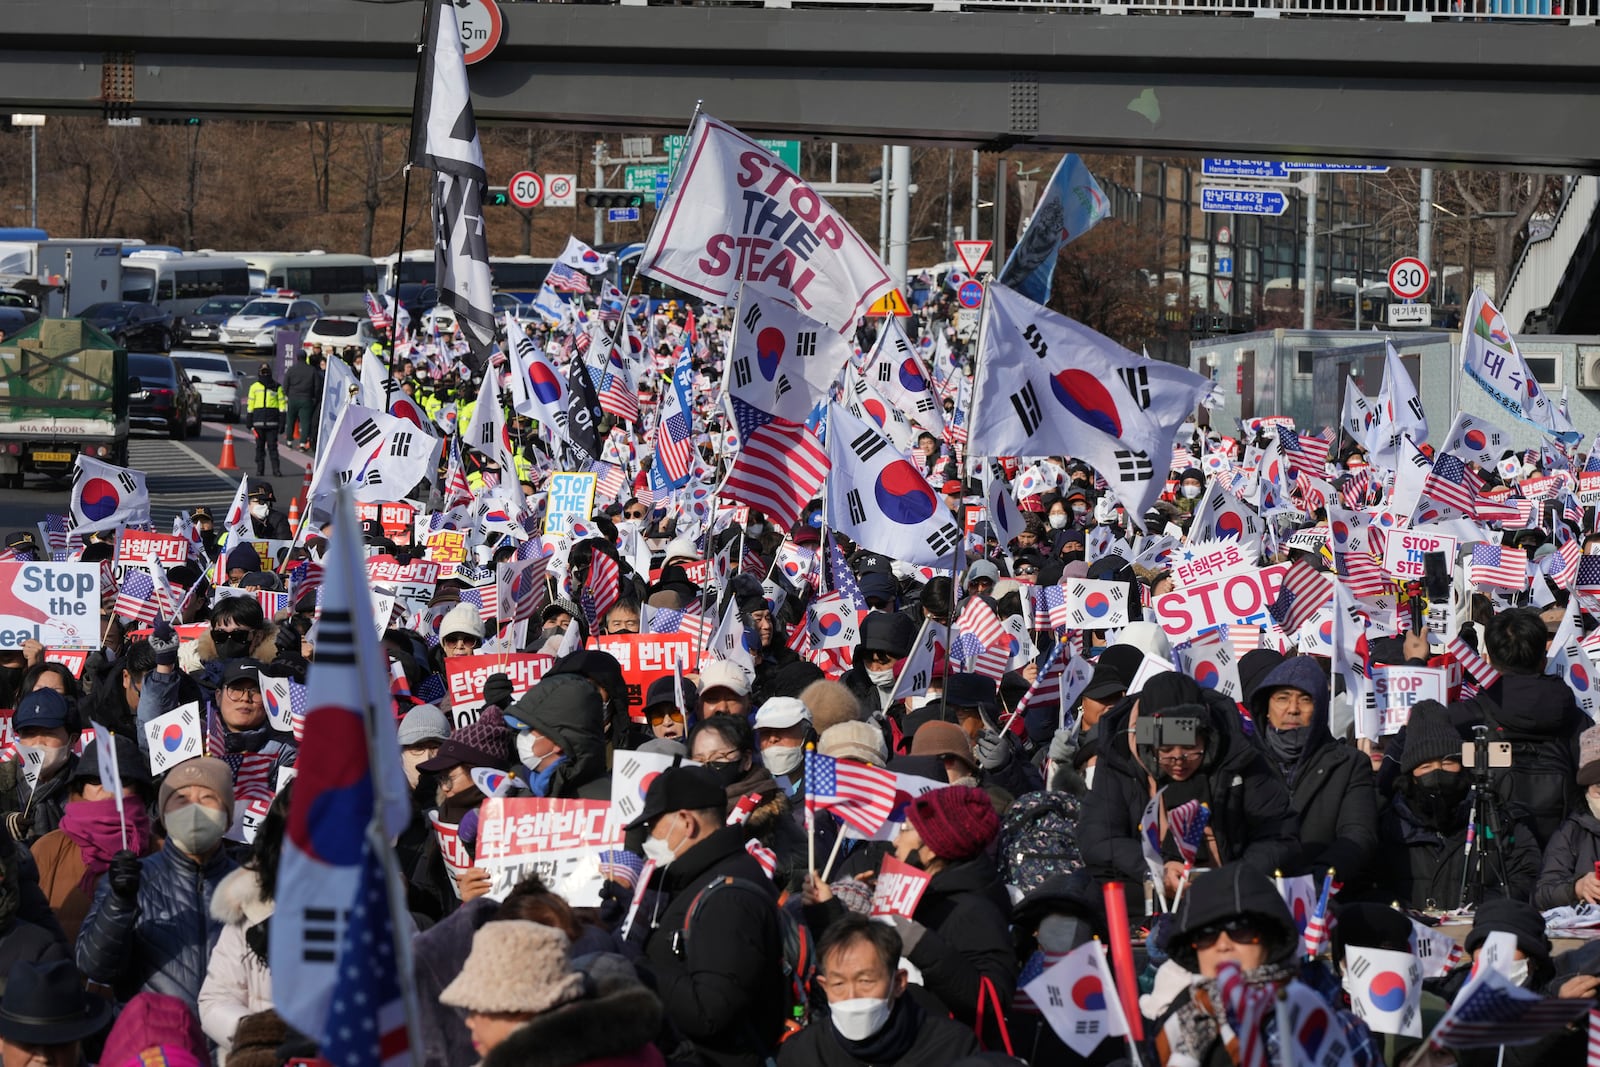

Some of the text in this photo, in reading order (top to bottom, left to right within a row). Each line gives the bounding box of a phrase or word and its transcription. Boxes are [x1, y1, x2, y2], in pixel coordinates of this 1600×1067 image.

[516, 181, 537, 199] 50
[1205, 190, 1264, 204] 한남대로42길
[736, 151, 844, 251] STOP
[742, 190, 821, 262] THE
[699, 233, 816, 311] STEAL
[1397, 269, 1421, 287] 30
[1391, 306, 1428, 316] 여기부터
[41, 425, 85, 433] MOTORS
[552, 475, 593, 495] STOP
[554, 496, 585, 512] THE
[428, 532, 464, 548] 내란
[1402, 536, 1440, 552] STOP
[118, 538, 188, 561] 탄핵반대
[1407, 549, 1424, 563] TH
[455, 565, 493, 582] 체포하라
[1177, 546, 1244, 586] 탄핵무효
[23, 566, 95, 598] Stop
[49, 597, 87, 616] the
[1157, 565, 1287, 635] STOP
[638, 642, 689, 671] 반대
[1375, 676, 1423, 694] STOP
[1382, 692, 1417, 708] THE
[481, 806, 624, 856] 탄핵반대
